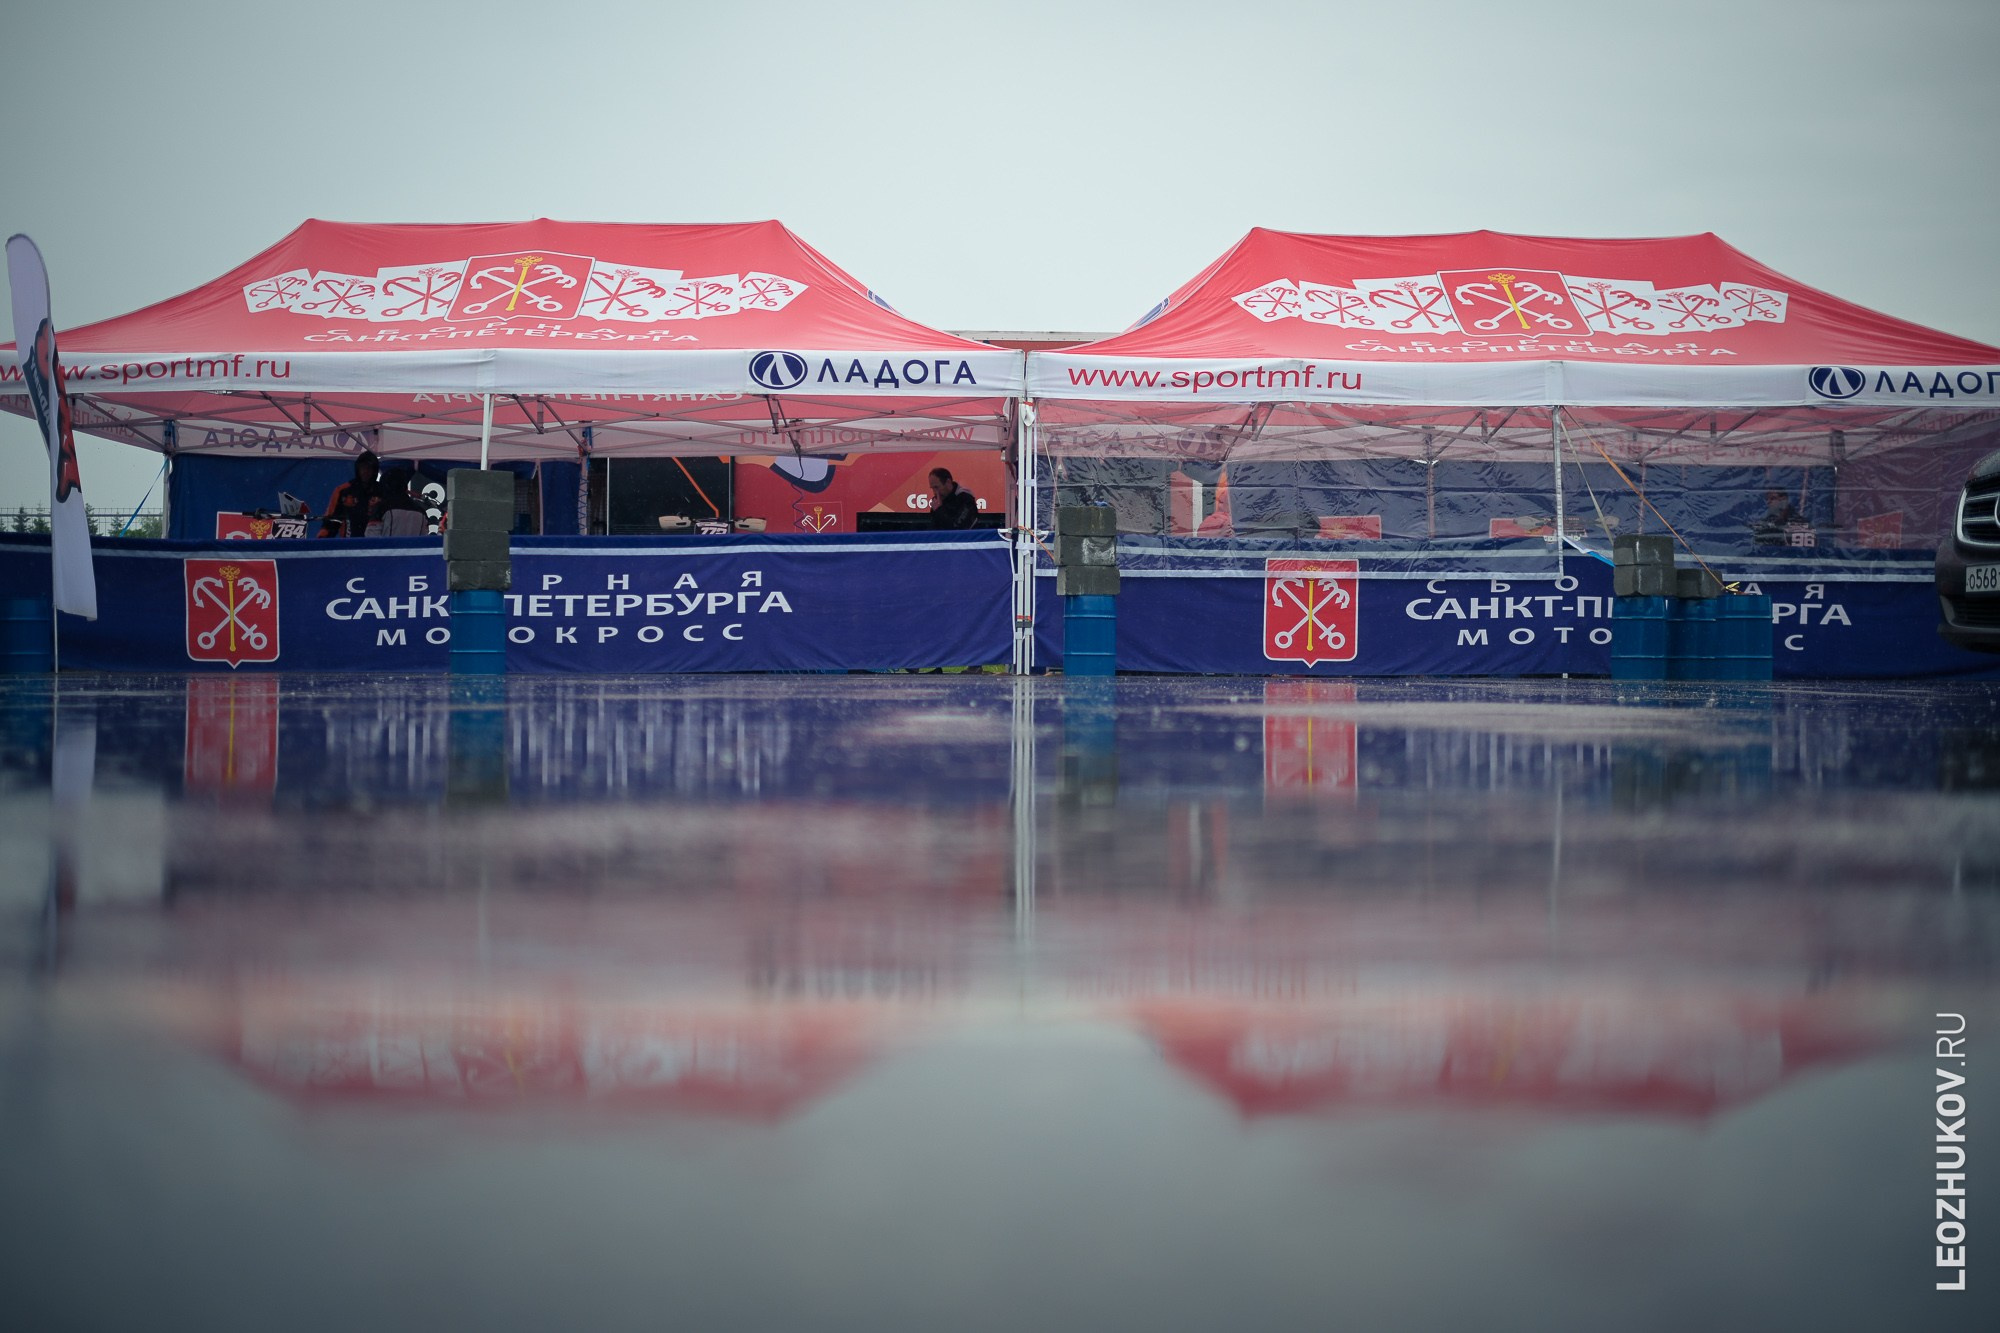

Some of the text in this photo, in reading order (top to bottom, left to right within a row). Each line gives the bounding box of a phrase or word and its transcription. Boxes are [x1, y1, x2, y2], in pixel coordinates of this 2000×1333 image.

[303, 327, 699, 343] САНКТ-ПЕТЕРБУРГА
[1345, 344, 1737, 356] САНКТ-ПЕТЕРБУРГА
[0, 354, 290, 385] ww.sportmf.ru
[817, 358, 977, 389] ЛАДОГА
[1068, 364, 1362, 394] www.sportmf.ru
[274, 523, 305, 539] 784
[346, 571, 762, 594] СБРНАЯ
[326, 591, 793, 621] САНКПЕТЕРБУРГА
[376, 623, 744, 646] МООКРОСС
